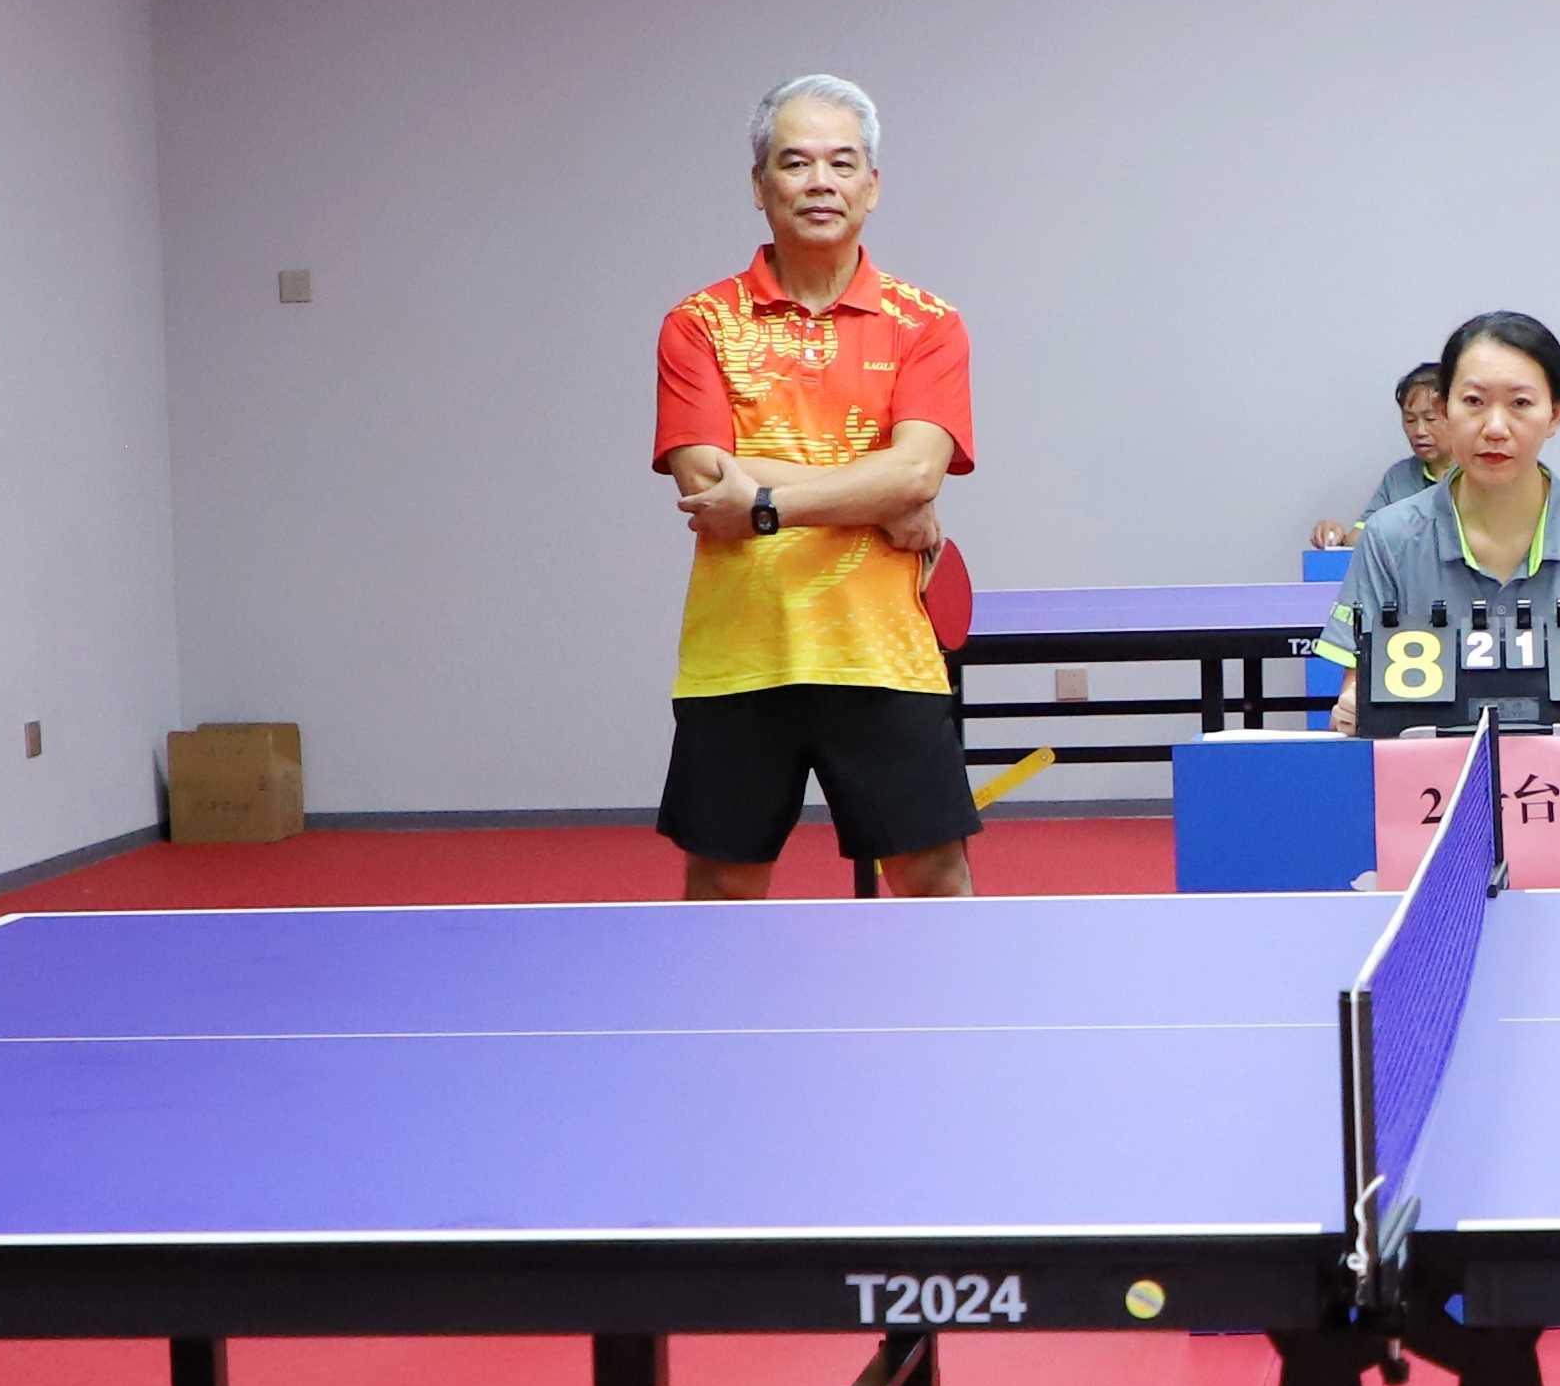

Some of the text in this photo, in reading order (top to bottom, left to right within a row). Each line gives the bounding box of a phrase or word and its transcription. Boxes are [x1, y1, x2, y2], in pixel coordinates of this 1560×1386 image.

[1384, 630, 1443, 698] 8
[1466, 631, 1494, 667] 2
[1516, 631, 1534, 666] 1
[1420, 773, 1560, 825] 2台
[846, 1274, 1027, 1324] T2024
